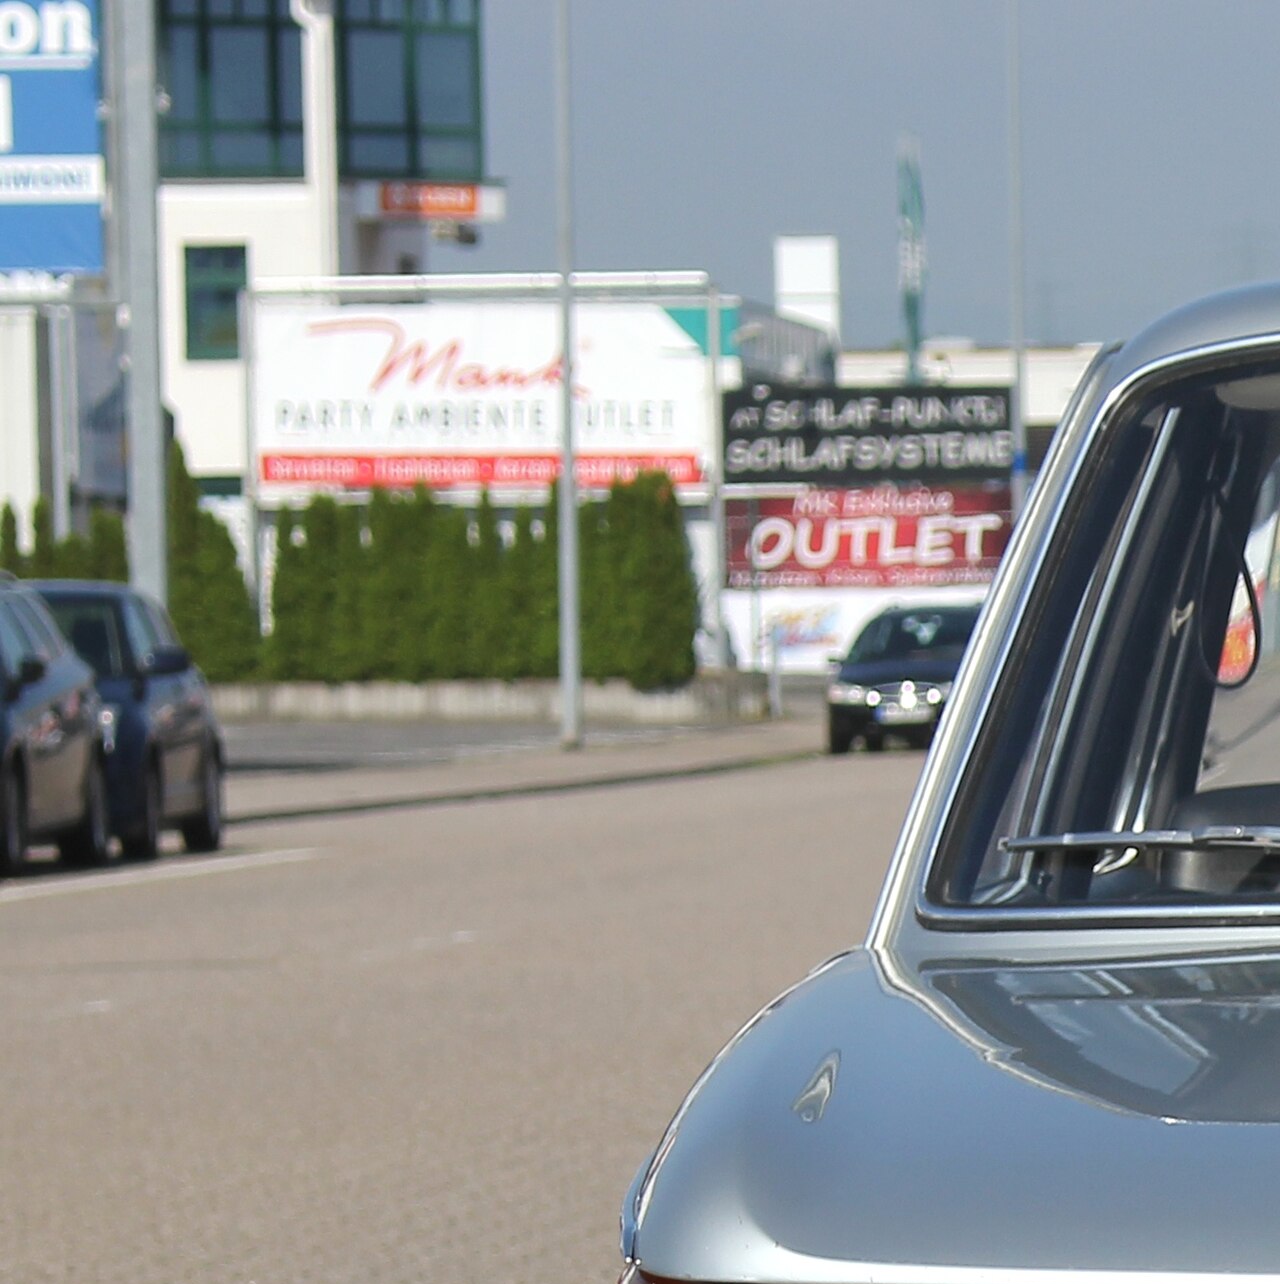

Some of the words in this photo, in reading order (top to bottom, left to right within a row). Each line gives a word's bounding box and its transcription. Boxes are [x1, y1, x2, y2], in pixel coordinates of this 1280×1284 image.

[275, 402, 373, 432] PARTY
[391, 401, 546, 431] AMBIENTE
[556, 401, 676, 430] UTLET
[724, 431, 1014, 471] SCHLAFSYSTEME
[747, 514, 1003, 569] OUTLET
